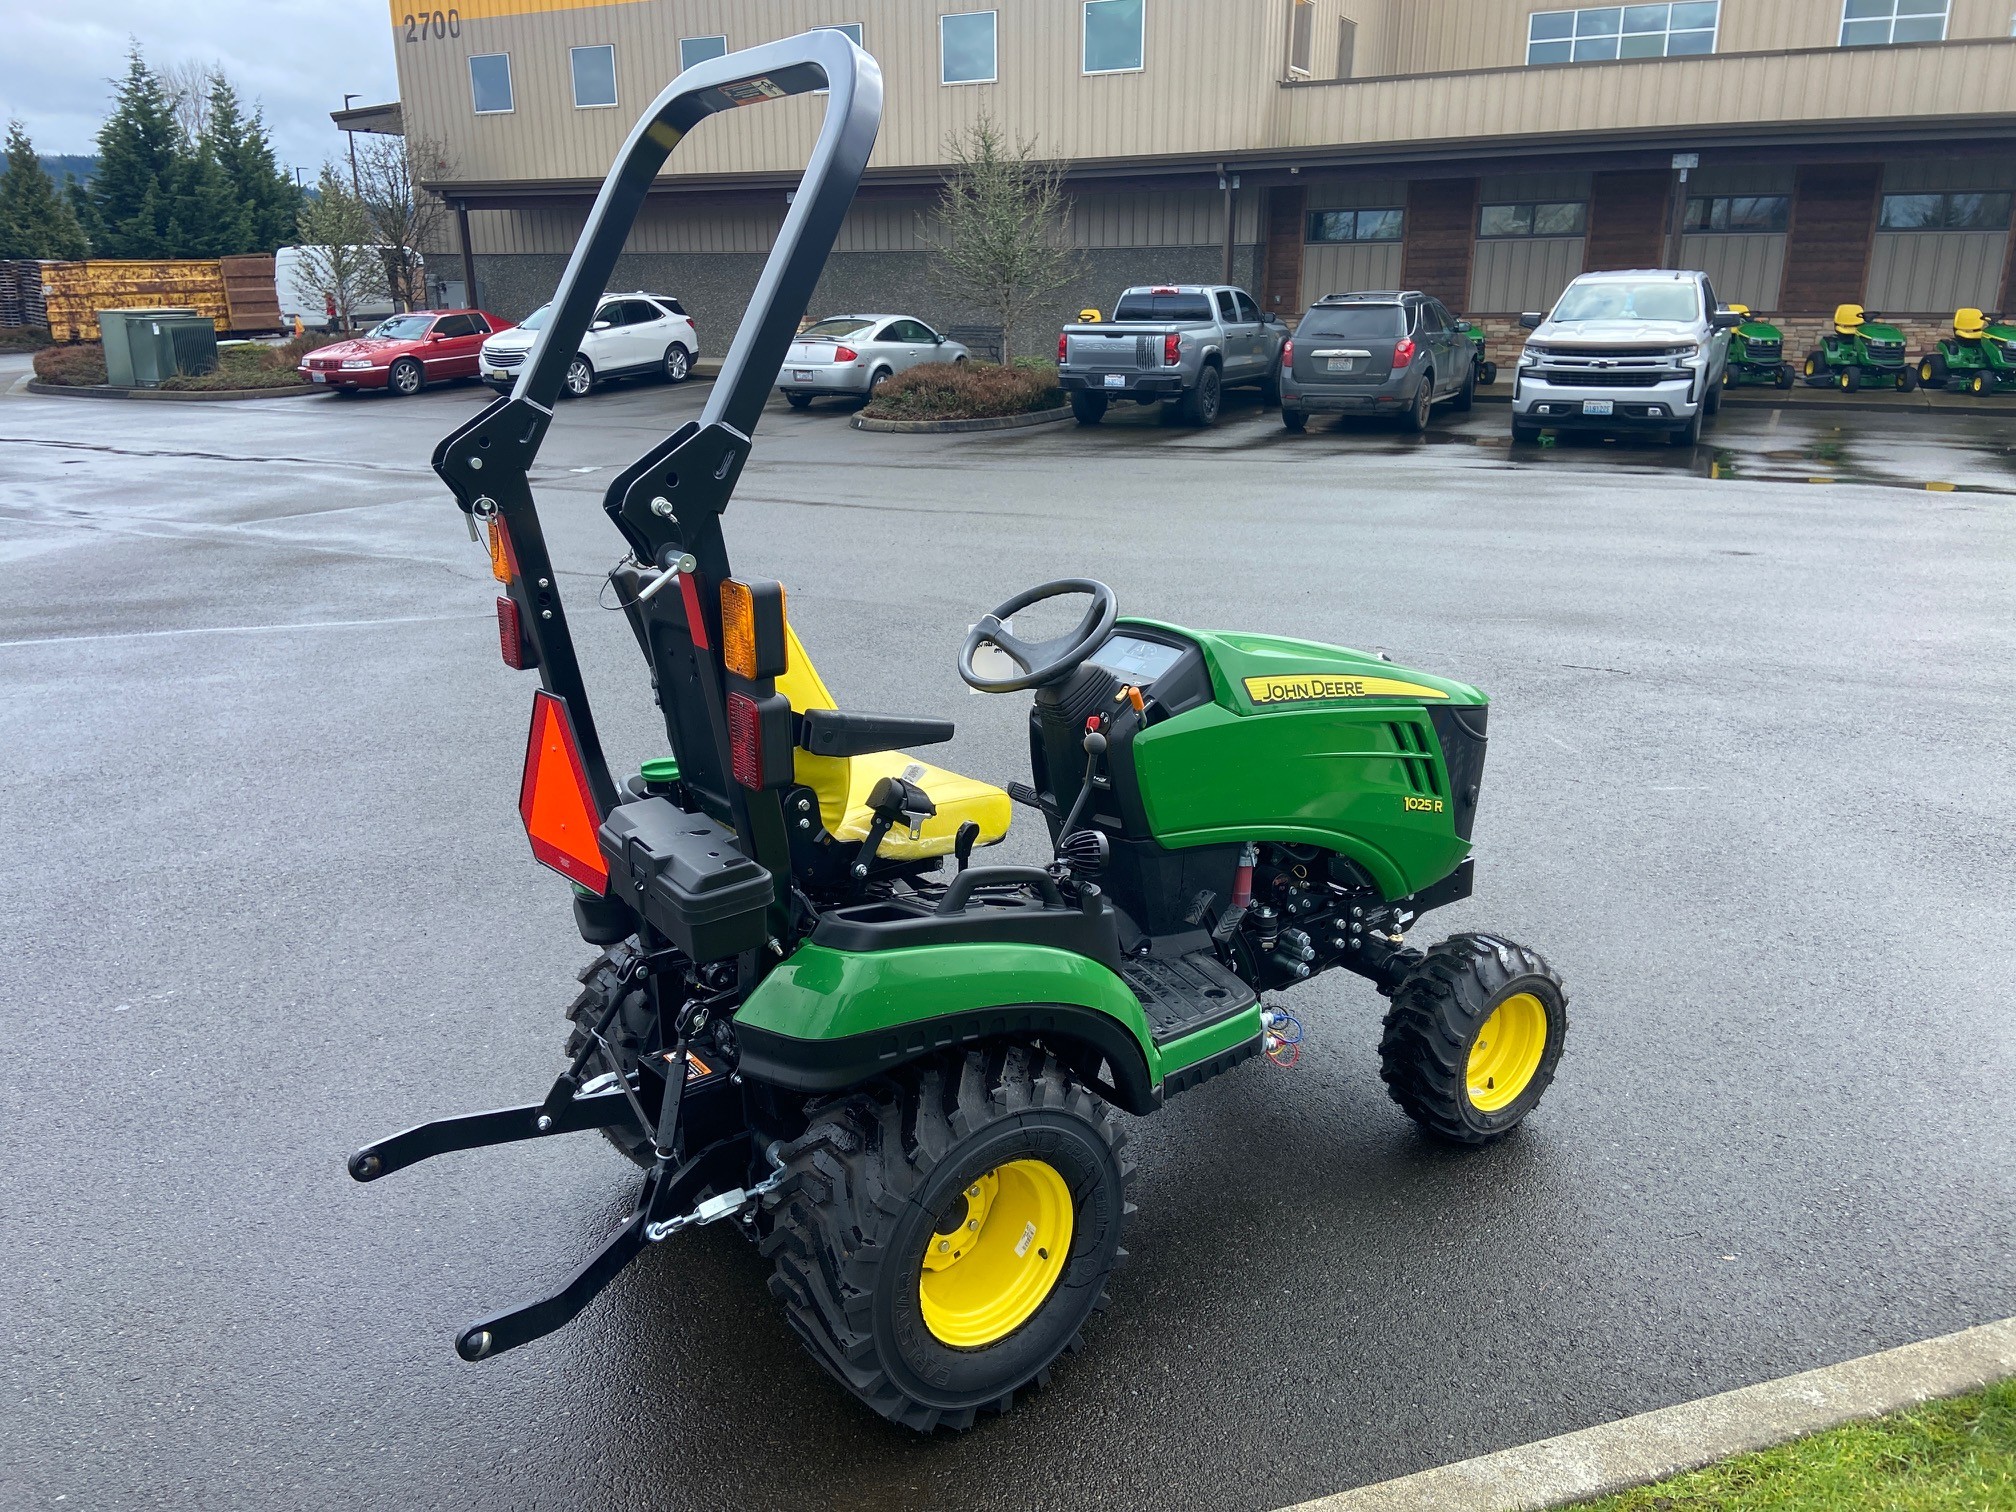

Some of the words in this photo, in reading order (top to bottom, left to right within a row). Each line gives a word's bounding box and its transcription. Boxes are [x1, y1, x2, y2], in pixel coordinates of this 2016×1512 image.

[404, 8, 461, 43] 2700
[1262, 683, 1309, 700] JOHN
[1311, 680, 1365, 697] DEERE
